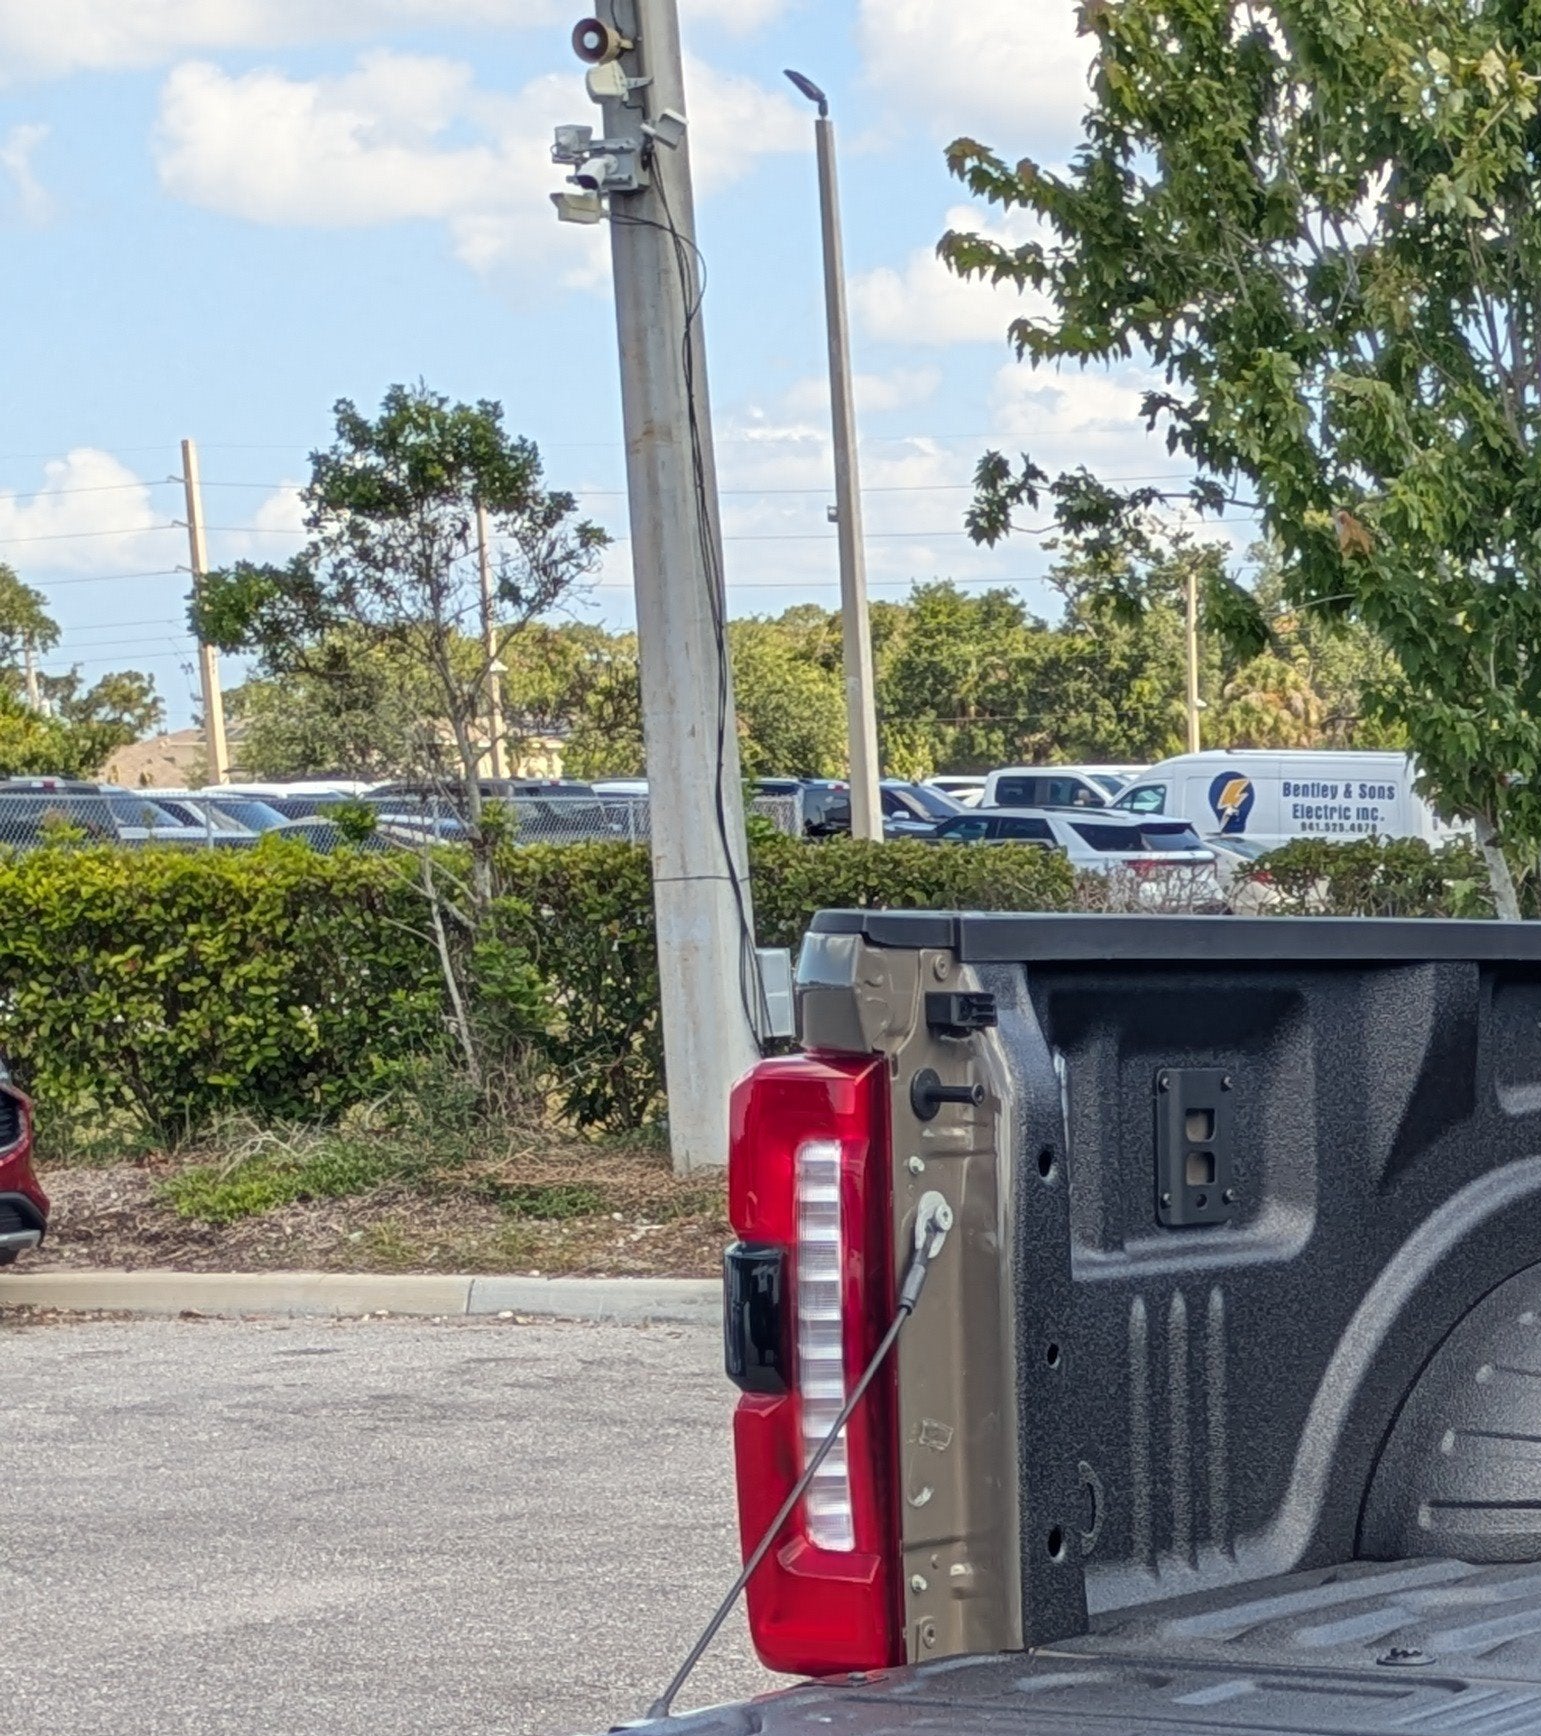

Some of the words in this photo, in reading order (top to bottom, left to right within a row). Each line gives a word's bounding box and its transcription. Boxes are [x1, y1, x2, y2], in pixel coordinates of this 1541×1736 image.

[1283, 782, 1338, 800] Bentley
[1343, 783, 1353, 799] &
[1359, 783, 1395, 800] Sons
[1292, 803, 1351, 820] Electric
